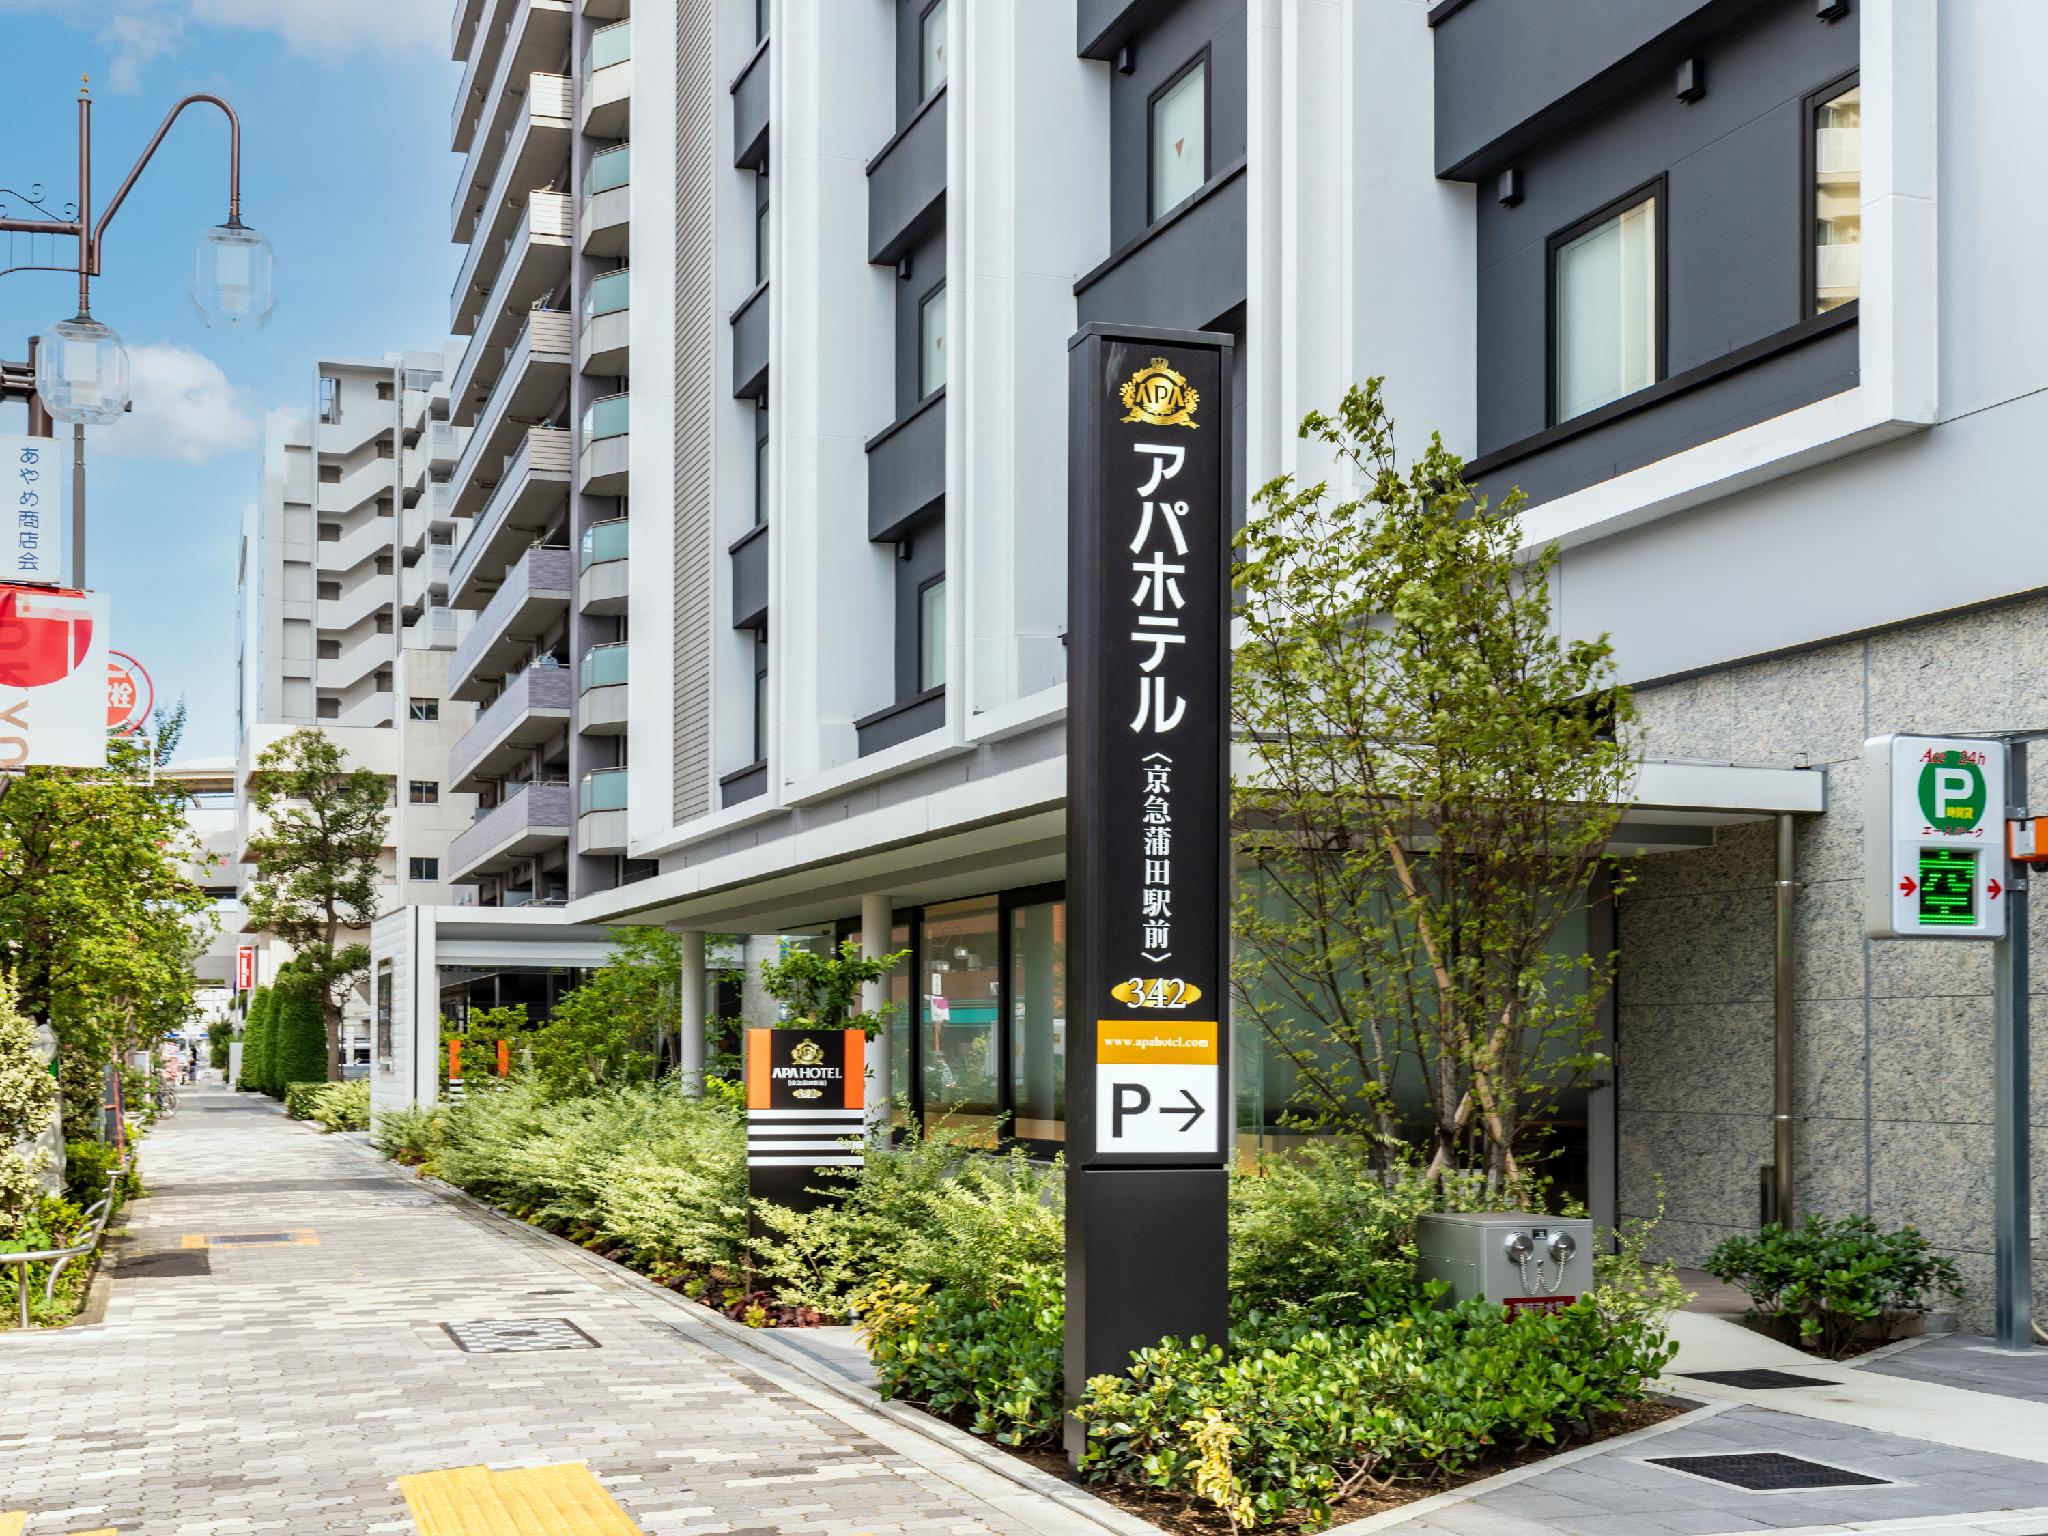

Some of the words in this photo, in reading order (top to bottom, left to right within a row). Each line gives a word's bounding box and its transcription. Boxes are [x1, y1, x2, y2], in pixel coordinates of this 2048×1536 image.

[18, 446, 40, 571] あやめ商店会
[1129, 443, 1189, 734] アパホテル
[1919, 747, 1947, 764] Ace
[1957, 750, 1986, 766] 24h
[1934, 767, 1975, 819] P
[1126, 977, 1187, 1009] 342
[1103, 1036, 1210, 1050] www.apahotel.com
[800, 1067, 843, 1079] HOTEL
[1112, 1082, 1151, 1138] P
